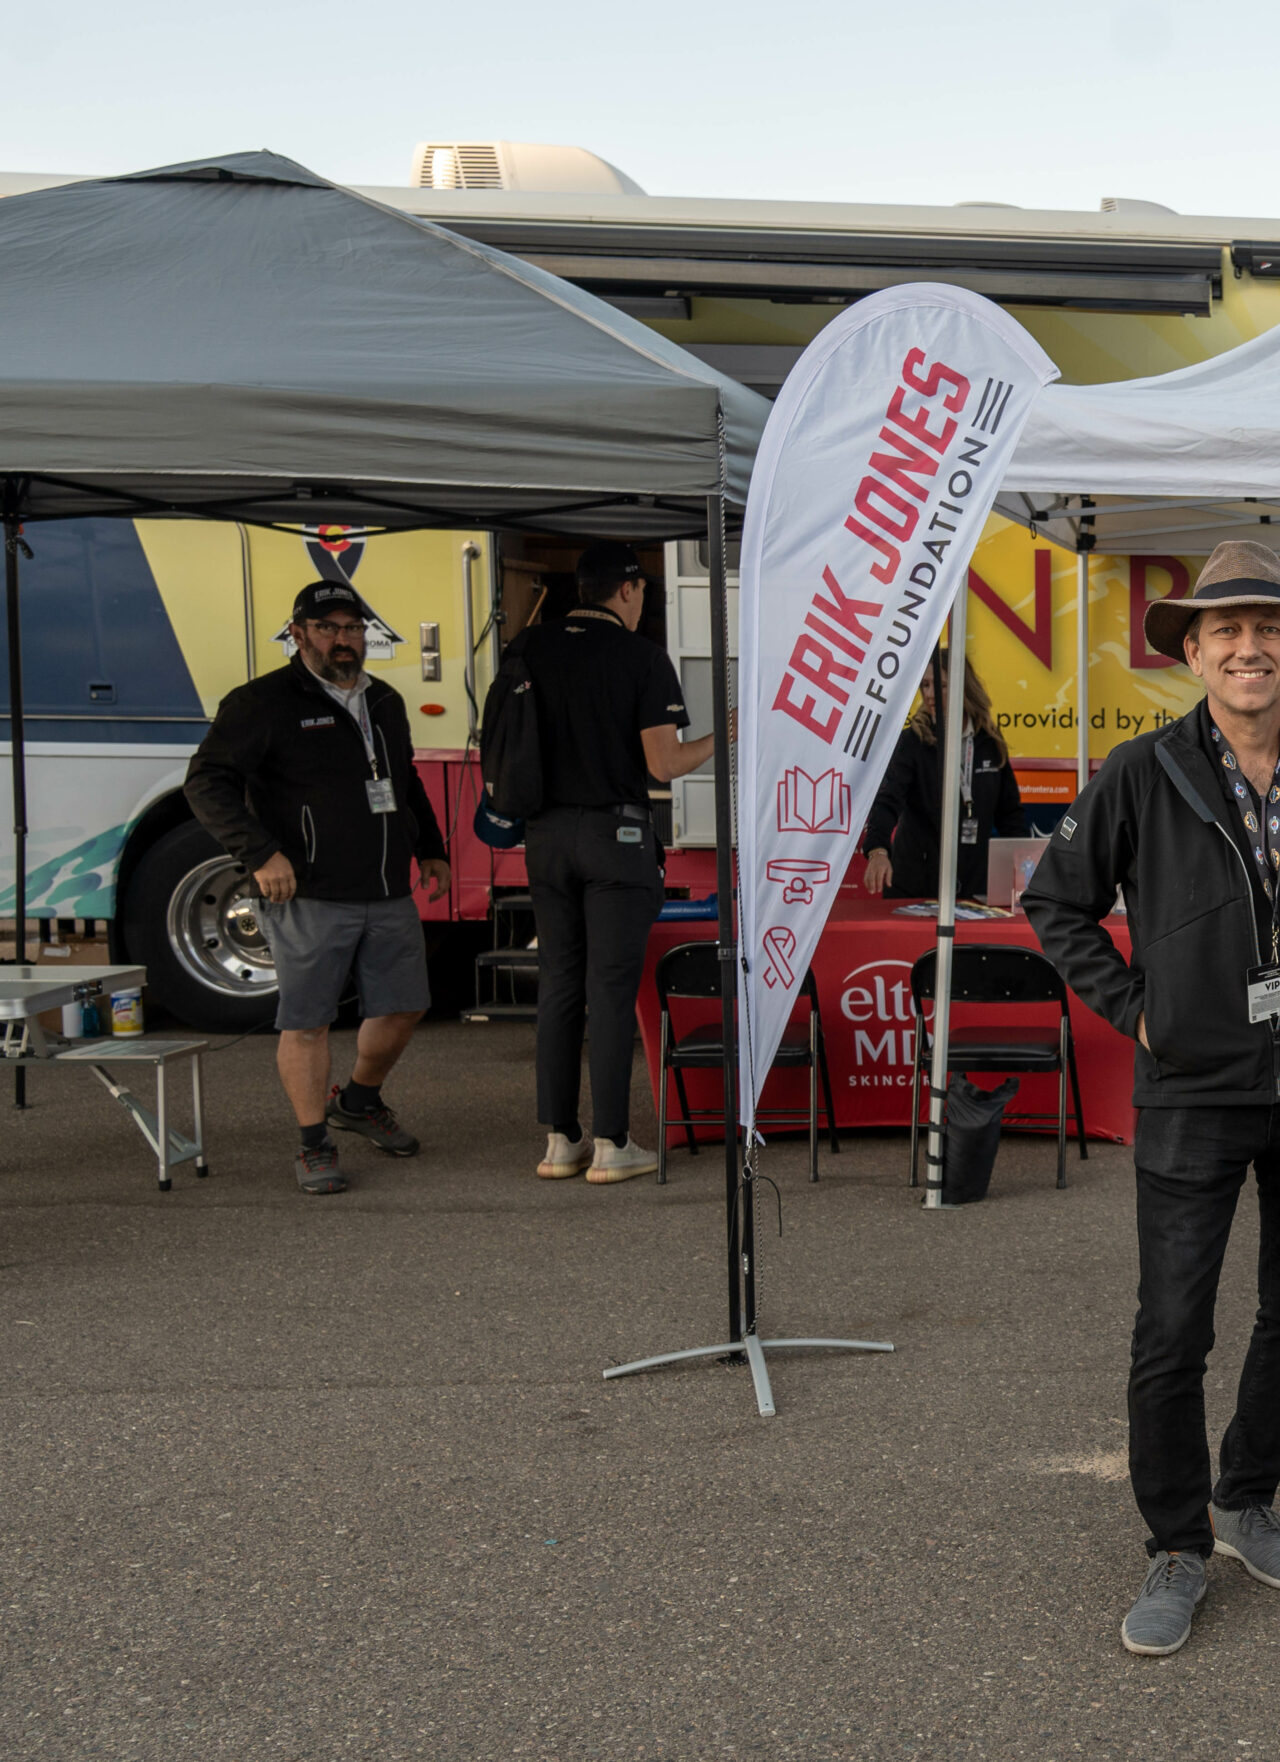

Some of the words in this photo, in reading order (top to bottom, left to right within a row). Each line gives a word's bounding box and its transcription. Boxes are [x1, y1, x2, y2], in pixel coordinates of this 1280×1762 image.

[771, 563, 884, 745] ERIK
[844, 346, 971, 585] JONES
[866, 436, 989, 704] FOUNDATION
[997, 707, 1105, 729] providd
[1117, 708, 1144, 735] by
[1265, 981, 1280, 991] VIP
[849, 1075, 931, 1087] SKINCR
